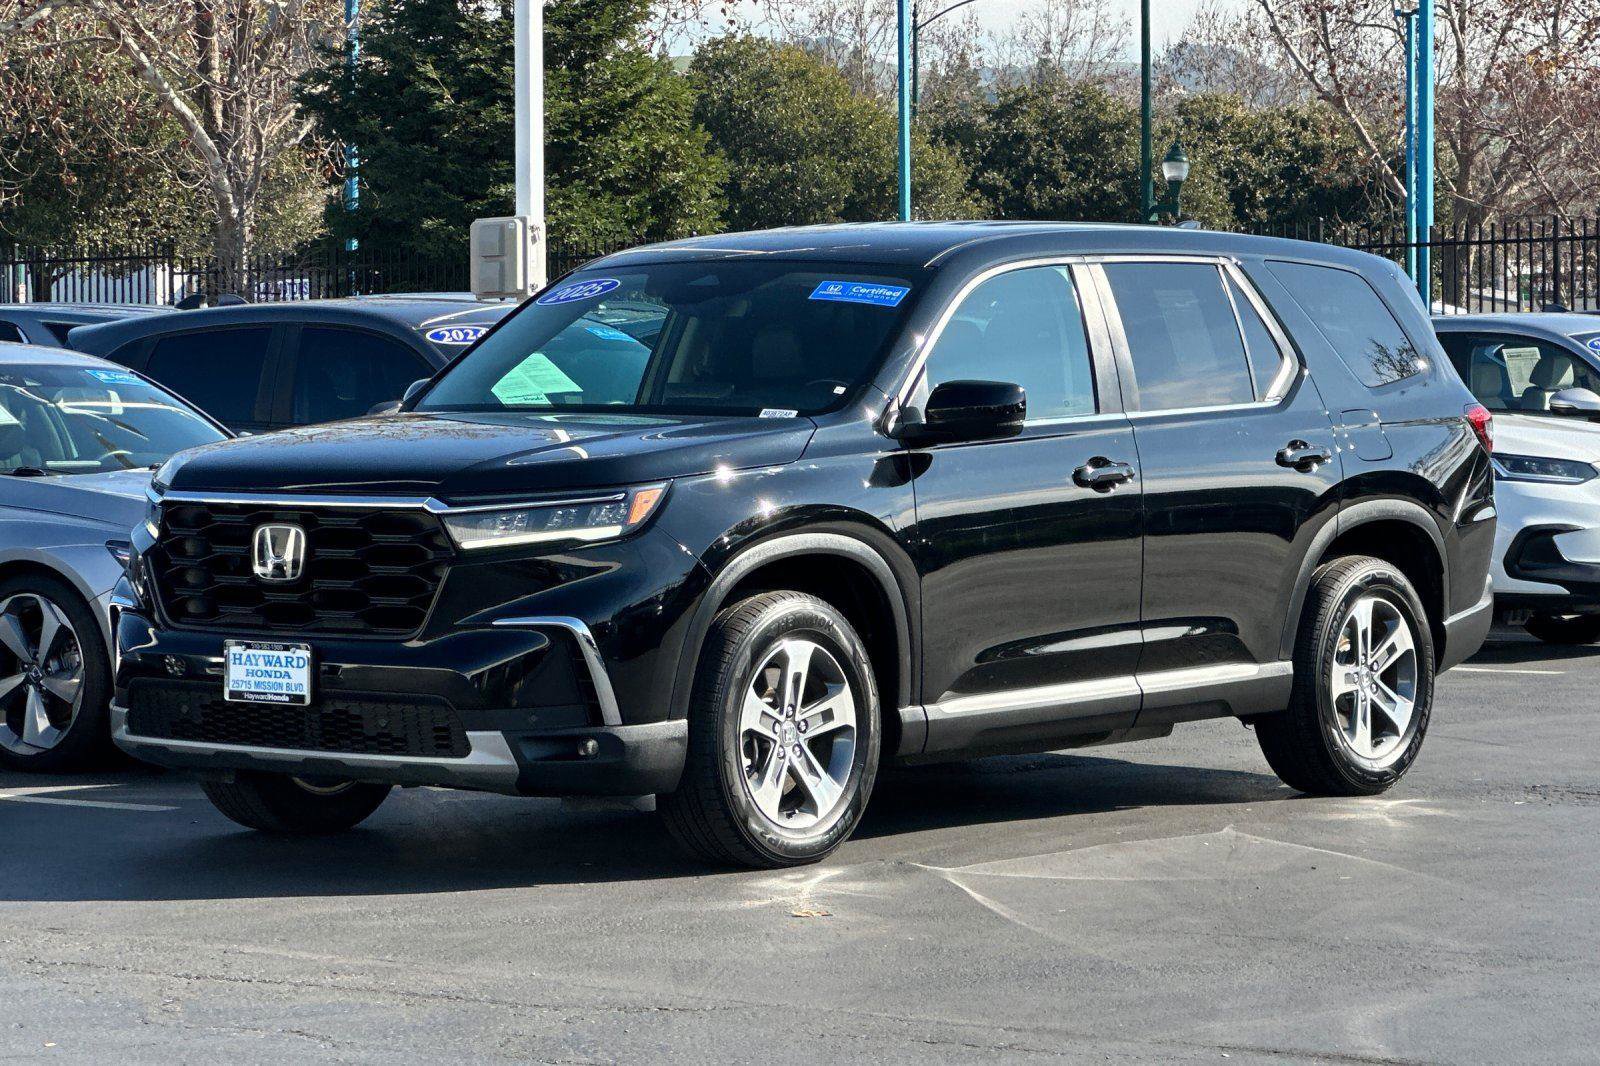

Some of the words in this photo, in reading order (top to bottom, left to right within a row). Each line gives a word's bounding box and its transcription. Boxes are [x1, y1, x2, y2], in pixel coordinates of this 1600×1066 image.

[544, 282, 612, 303] 2025
[852, 285, 902, 297] Certified
[231, 652, 307, 669] HAYWARD
[245, 668, 293, 680] HONDA
[231, 680, 252, 690] 25715
[254, 681, 284, 691] MISSION
[285, 683, 305, 693] BLVD.
